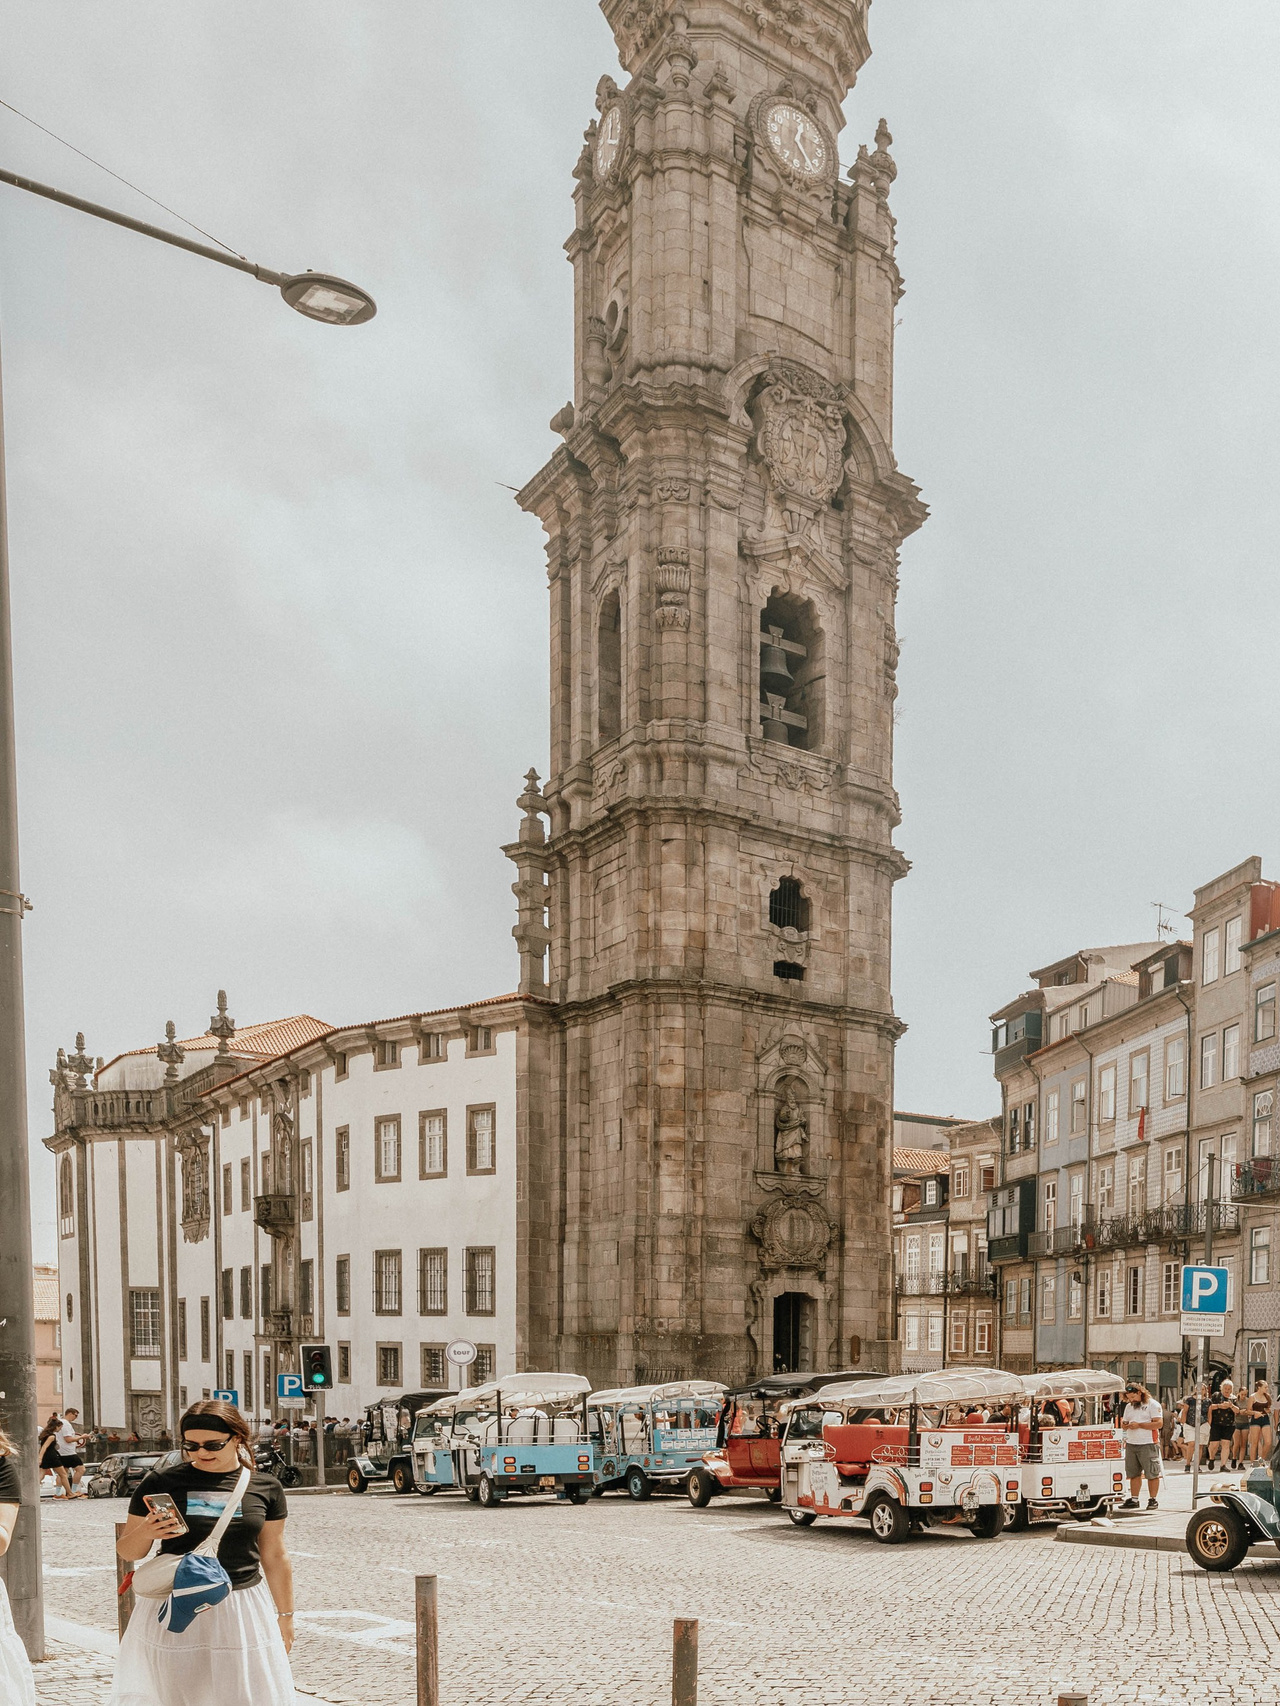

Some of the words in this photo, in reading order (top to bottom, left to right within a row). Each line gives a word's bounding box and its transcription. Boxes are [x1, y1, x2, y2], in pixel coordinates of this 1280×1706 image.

[774, 114, 783, 124] 10
[783, 110, 790, 120] 11
[792, 112, 802, 122] 12
[770, 122, 778, 132] 9
[774, 136, 781, 146] 8
[812, 136, 820, 144] 2
[783, 149, 790, 158] 7
[816, 148, 822, 158] 3
[792, 158, 800, 168] 6
[812, 159, 820, 168] 4
[1191, 1271, 1219, 1309] P
[283, 1376, 301, 1396] P
